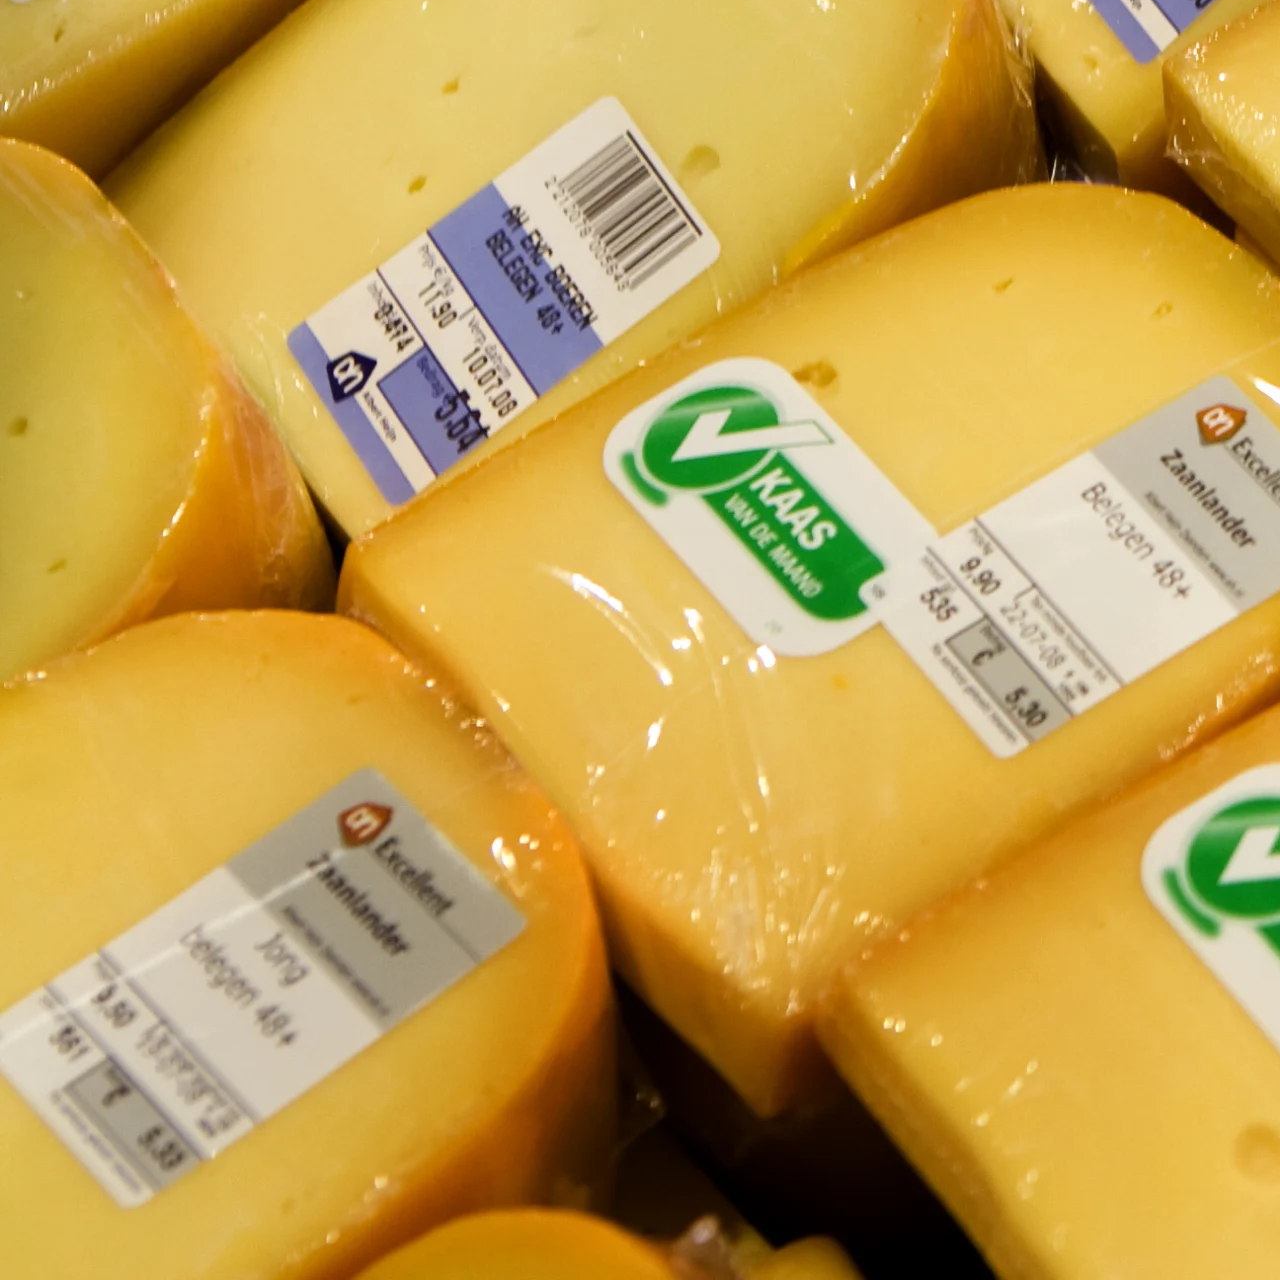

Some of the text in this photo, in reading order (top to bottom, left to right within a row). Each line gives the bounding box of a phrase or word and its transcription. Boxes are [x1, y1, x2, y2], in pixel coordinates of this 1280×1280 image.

[416, 279, 461, 330] 11.90
[484, 228, 567, 337] BELEGEN 48+
[500, 203, 598, 331] AH EXC BOEREN
[432, 387, 492, 455] 5.64
[461, 345, 518, 419] 10.07.08
[747, 452, 839, 555] KAAS
[1076, 479, 1195, 601] Belegen 48+
[1158, 446, 1258, 550] Zaanlander
[722, 489, 824, 600] VAN DE MAAND
[957, 554, 1004, 597] 9,90
[917, 584, 961, 623] 535
[1002, 685, 1050, 729] 5,30
[304, 849, 411, 958] Zaanlander
[372, 834, 456, 919] Excellent
[175, 921, 262, 1011] belegen
[251, 929, 313, 989] Jong
